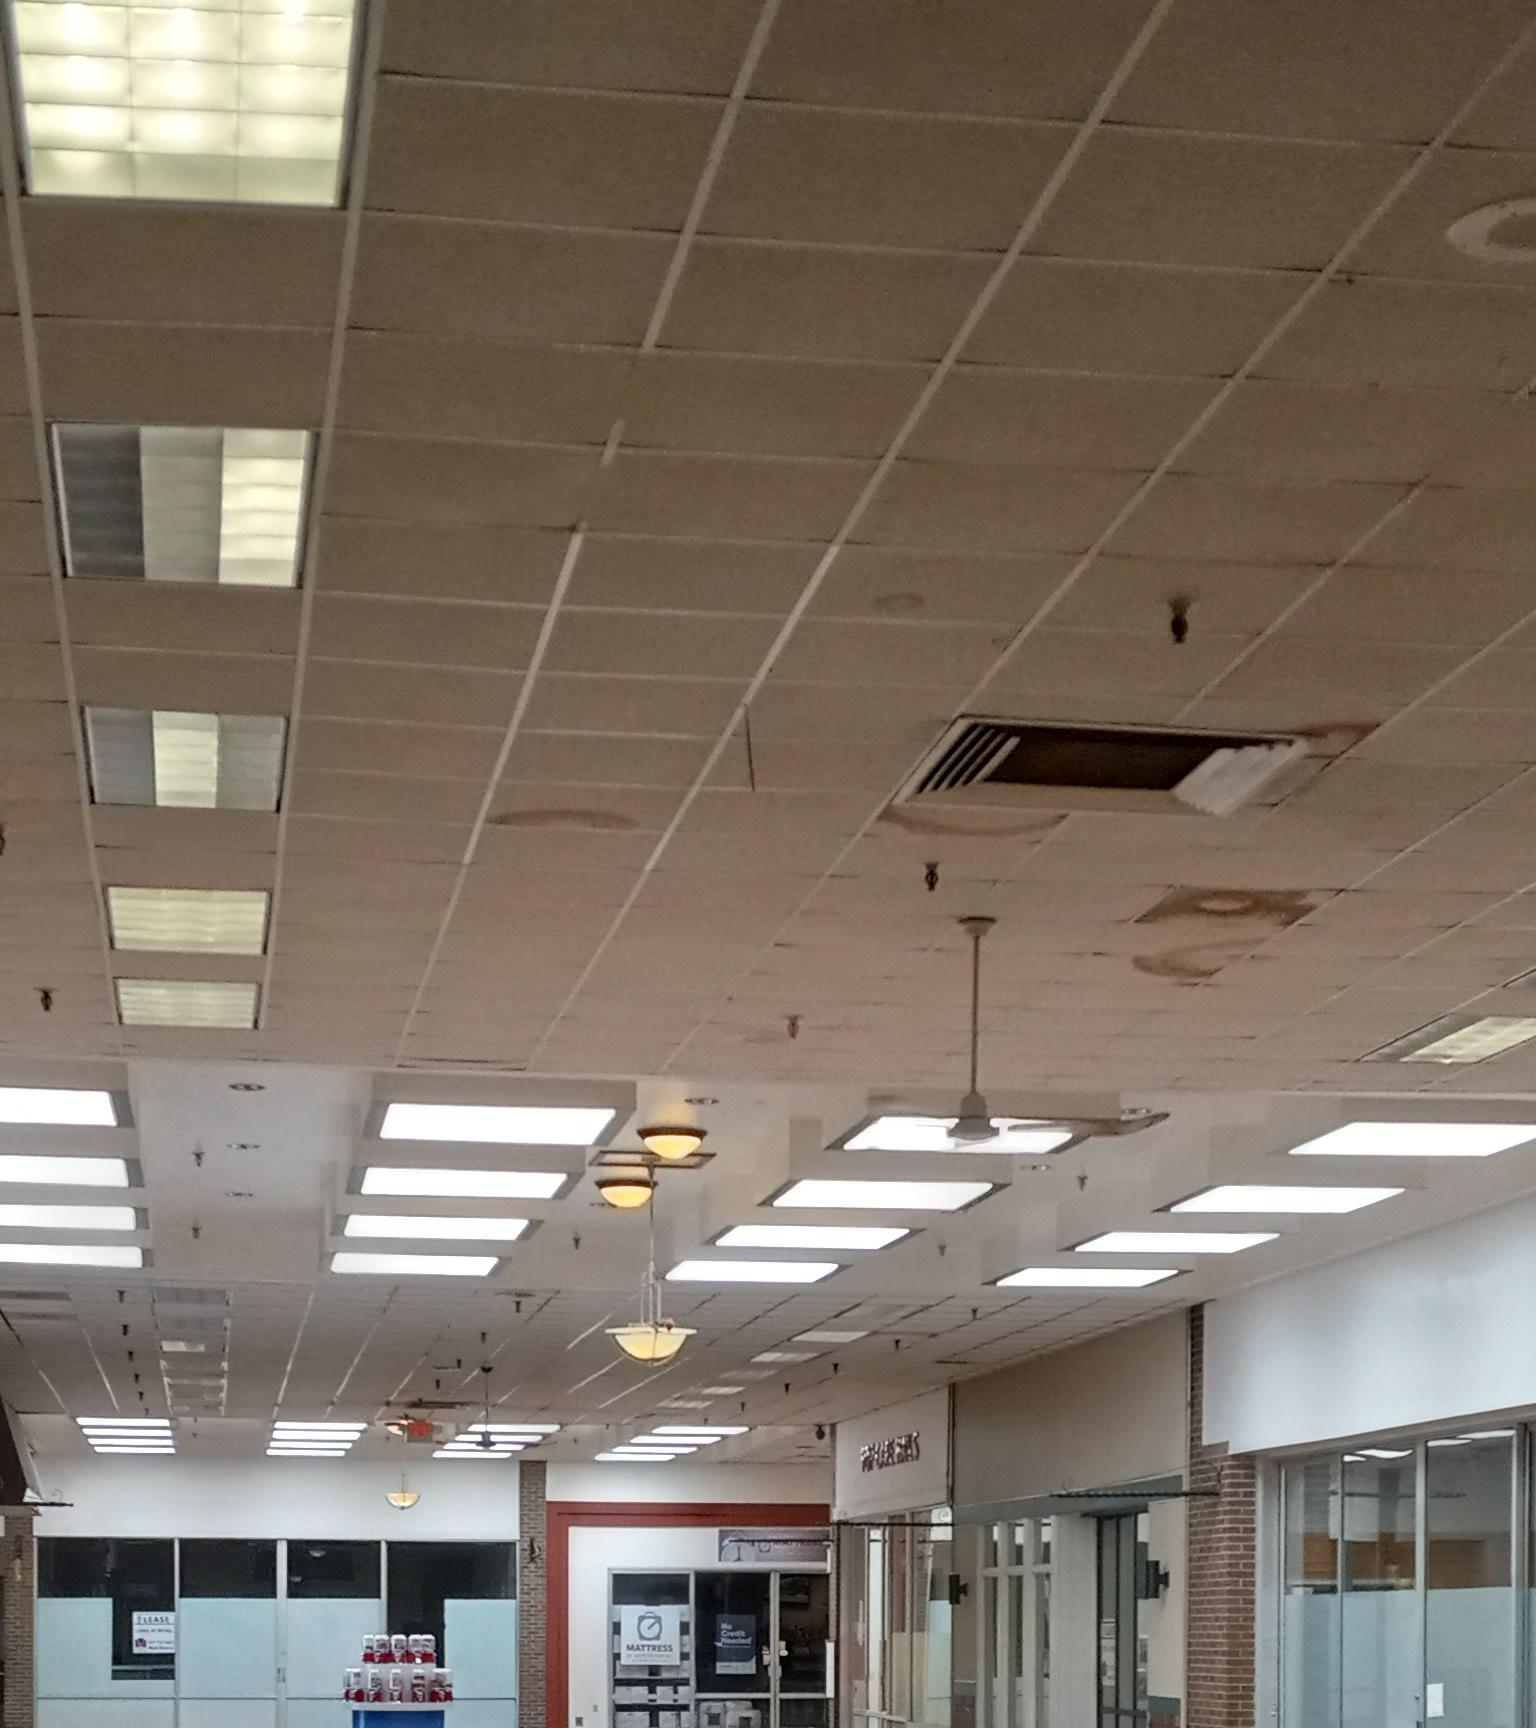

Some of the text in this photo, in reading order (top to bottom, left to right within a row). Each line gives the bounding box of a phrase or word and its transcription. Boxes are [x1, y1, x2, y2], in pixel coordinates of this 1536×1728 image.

[721, 1623, 732, 1631] No
[721, 1630, 746, 1638] Credit
[626, 1644, 673, 1652] MATTRESS
